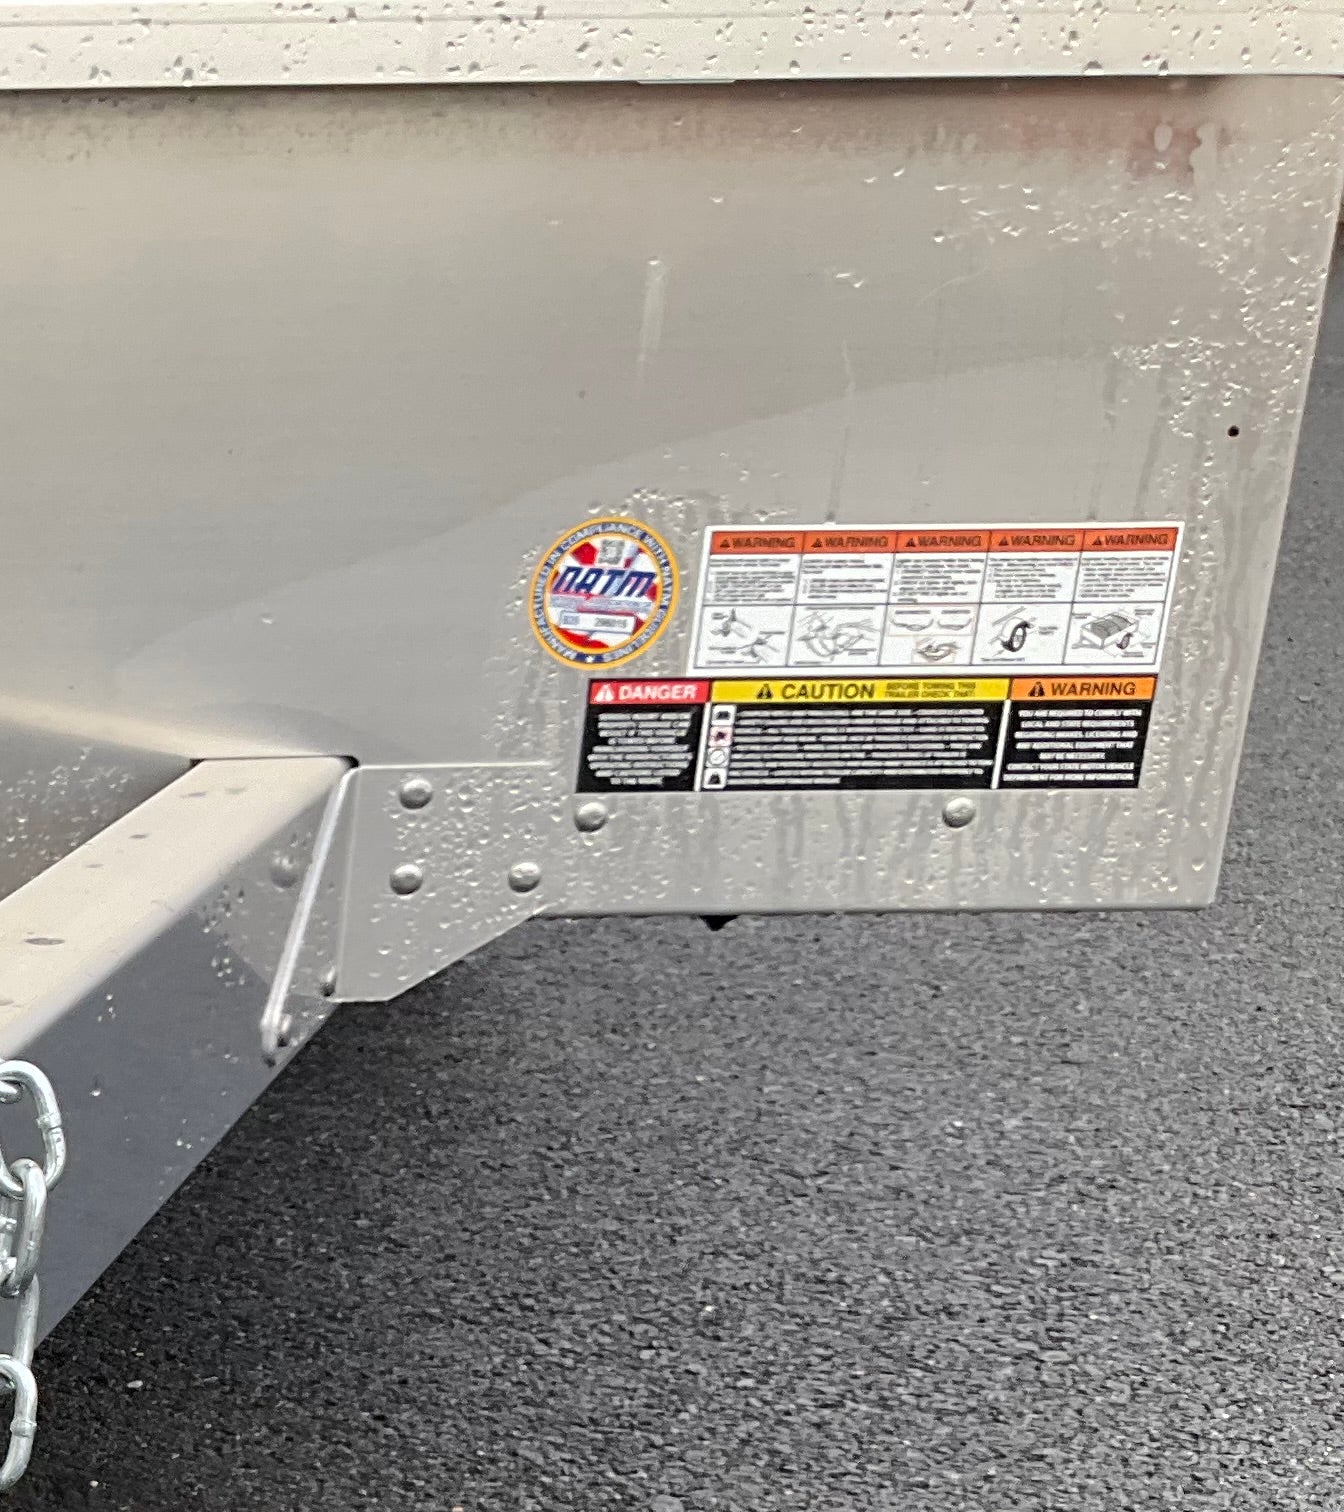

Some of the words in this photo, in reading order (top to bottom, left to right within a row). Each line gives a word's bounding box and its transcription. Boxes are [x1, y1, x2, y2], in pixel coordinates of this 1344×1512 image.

[733, 537, 795, 548] WARNING
[825, 536, 888, 547] WARNING
[918, 536, 981, 546] WARNING
[1012, 535, 1076, 546] WARNING
[1105, 534, 1168, 545] WARNING
[619, 685, 696, 700] DANGER
[781, 683, 875, 699] CAUTION
[1051, 682, 1136, 696] WARNING
